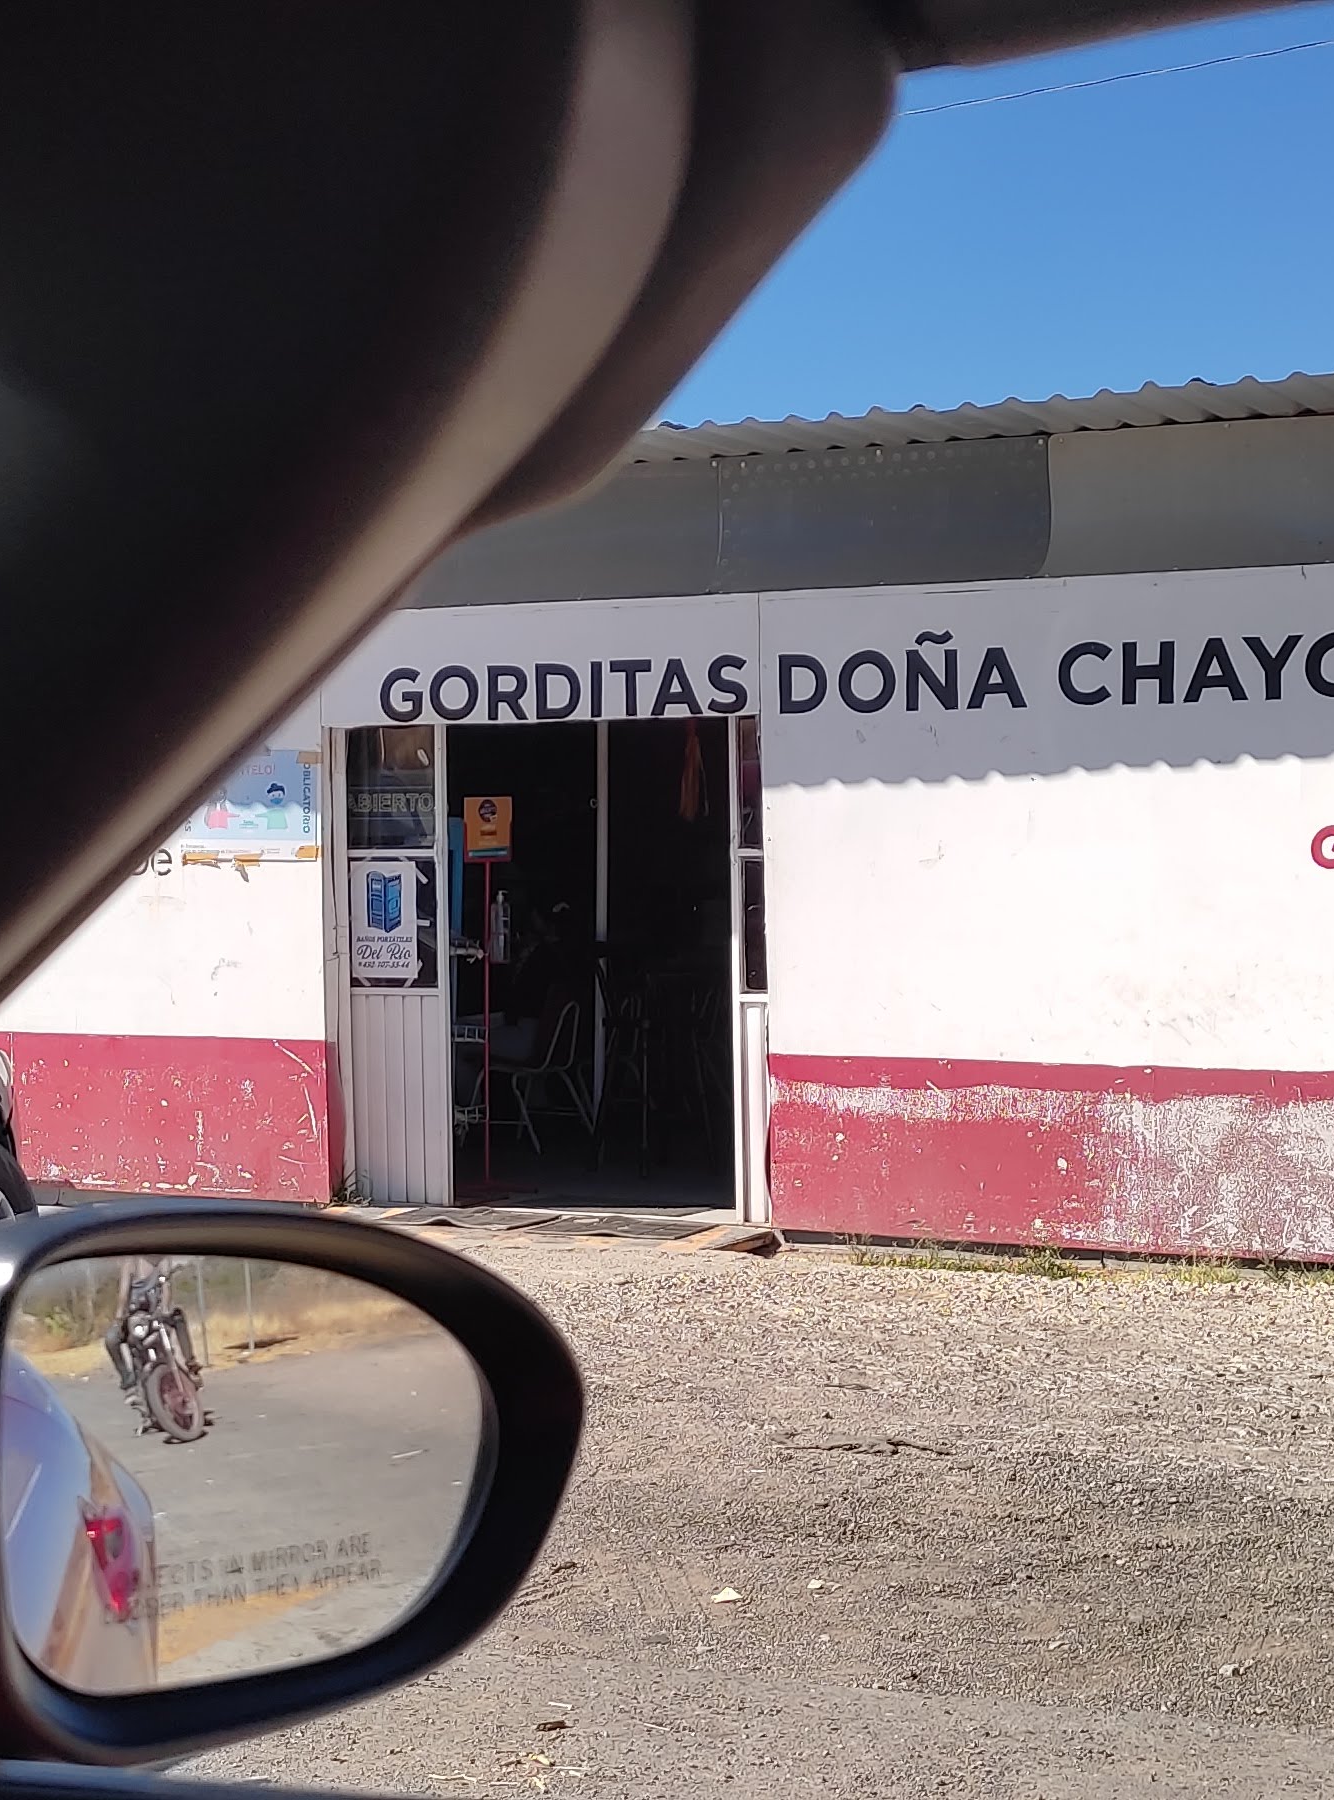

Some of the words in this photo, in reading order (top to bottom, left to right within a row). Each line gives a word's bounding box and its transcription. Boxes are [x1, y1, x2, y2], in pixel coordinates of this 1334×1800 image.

[379, 654, 749, 722] GORDITAS
[778, 630, 1028, 714] DOÑA
[356, 944, 383, 959] Del
